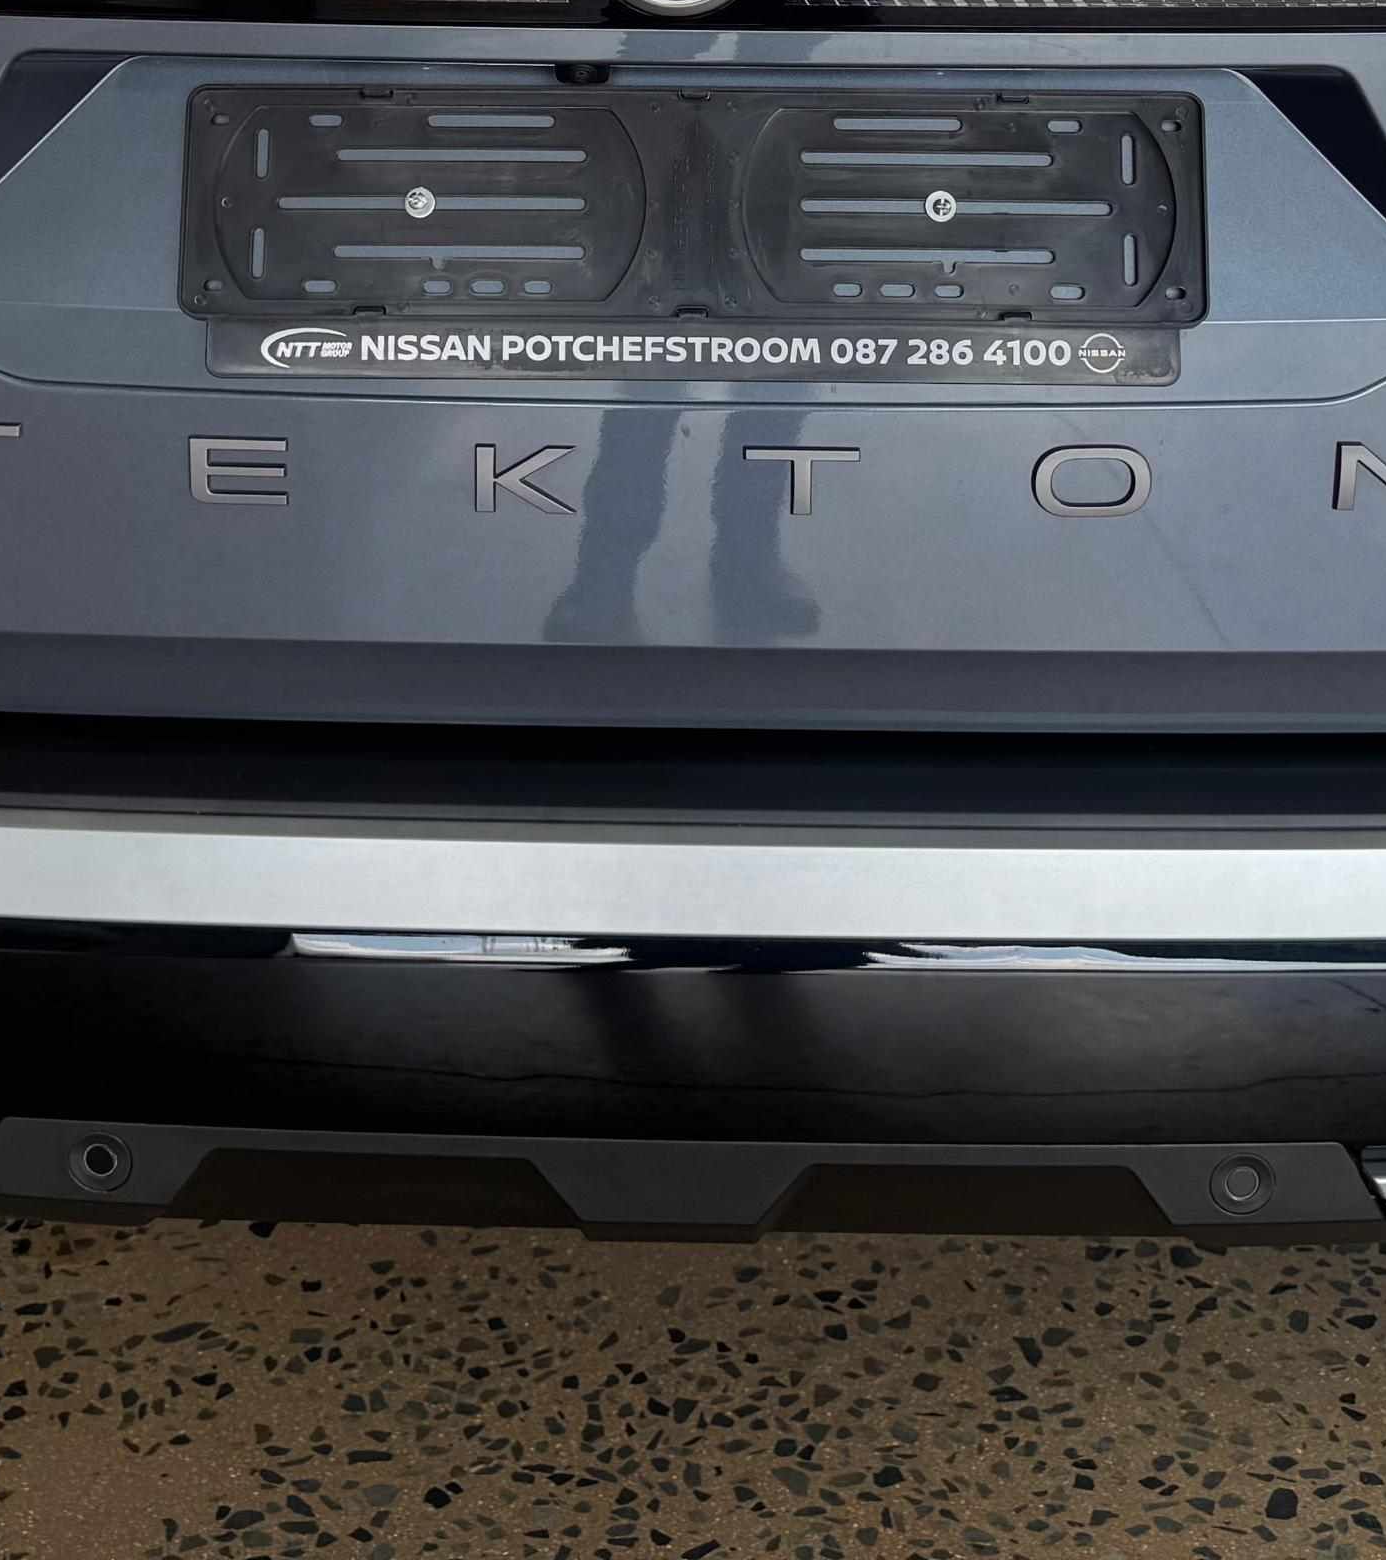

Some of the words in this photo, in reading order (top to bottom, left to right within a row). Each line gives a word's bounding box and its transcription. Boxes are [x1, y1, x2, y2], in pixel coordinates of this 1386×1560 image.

[276, 341, 321, 358] NTT
[321, 341, 353, 351] MOTOR
[320, 349, 351, 358] GROUP
[360, 335, 491, 362] NISSAN
[502, 335, 821, 364] POTCHEFSTROOM
[830, 337, 898, 365] 087
[906, 338, 974, 366] 286
[982, 339, 1072, 368] 4100
[1078, 348, 1127, 358] NISSAN
